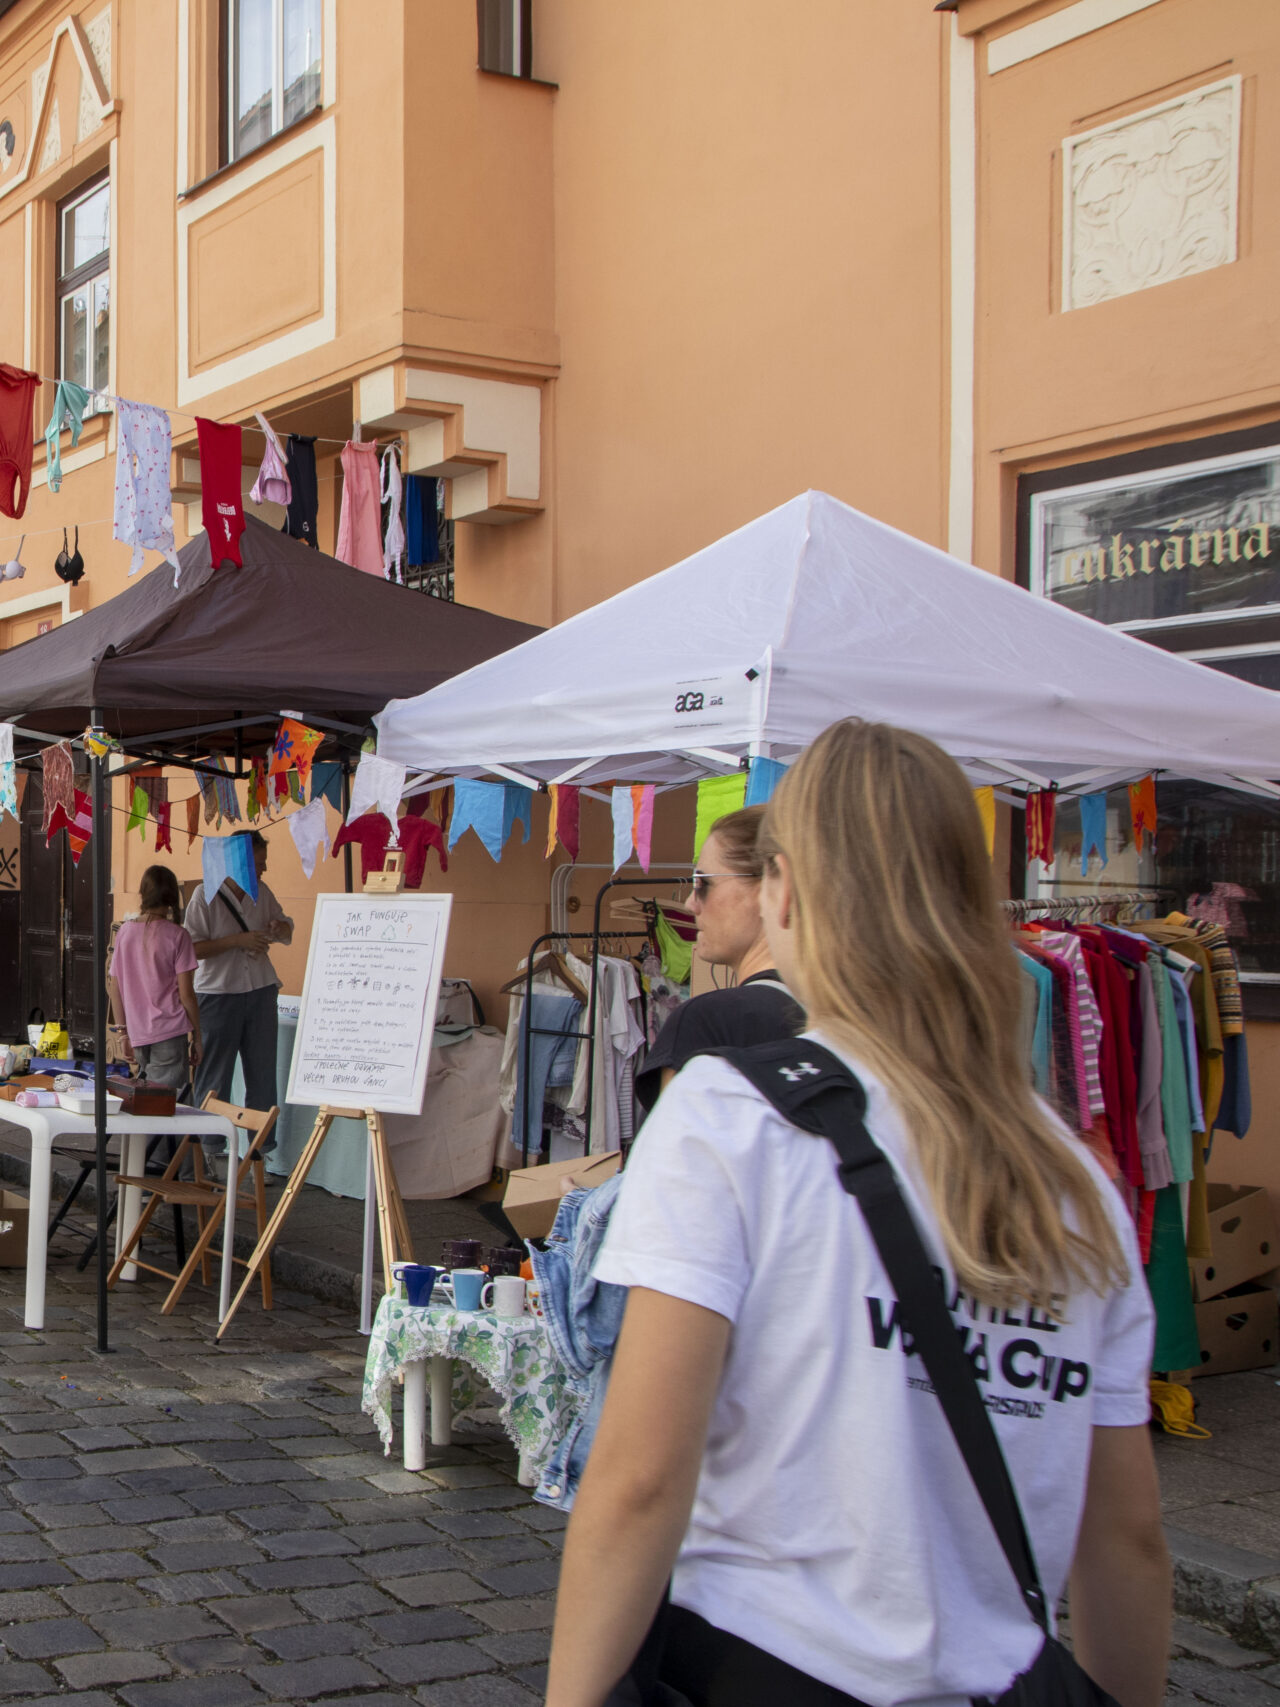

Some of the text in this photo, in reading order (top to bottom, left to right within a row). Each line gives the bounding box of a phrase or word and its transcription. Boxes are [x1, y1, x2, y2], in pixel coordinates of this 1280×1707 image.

[1063, 518, 1272, 584] cukrárna
[346, 912, 363, 923] JAK
[343, 925, 372, 938] SWAP
[332, 1073, 360, 1084] DRUHOU
